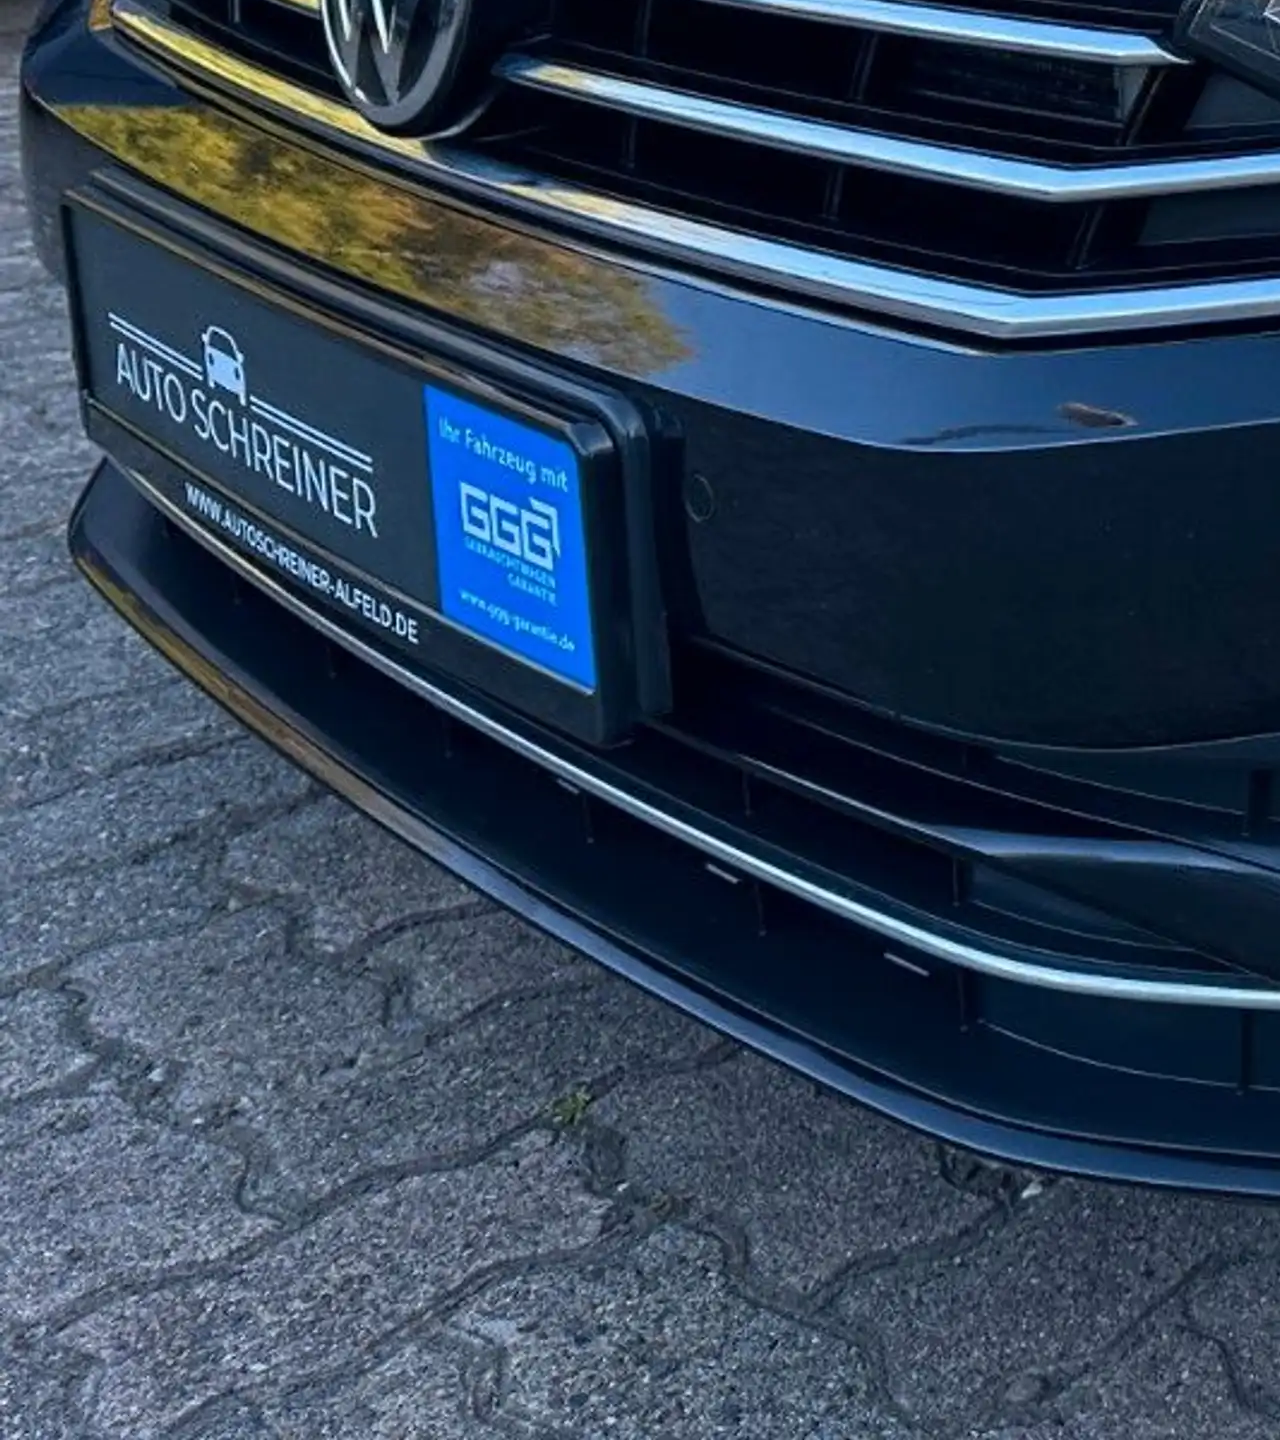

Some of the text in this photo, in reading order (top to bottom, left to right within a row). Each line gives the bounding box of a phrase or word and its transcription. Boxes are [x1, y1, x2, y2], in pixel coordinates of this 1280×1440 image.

[116, 342, 379, 539] AUTO SCHREINER
[439, 416, 569, 493] Ihr Fahrzeug mit
[184, 481, 420, 645] WWW.AUTOSCHREINER-ALFELD.DE
